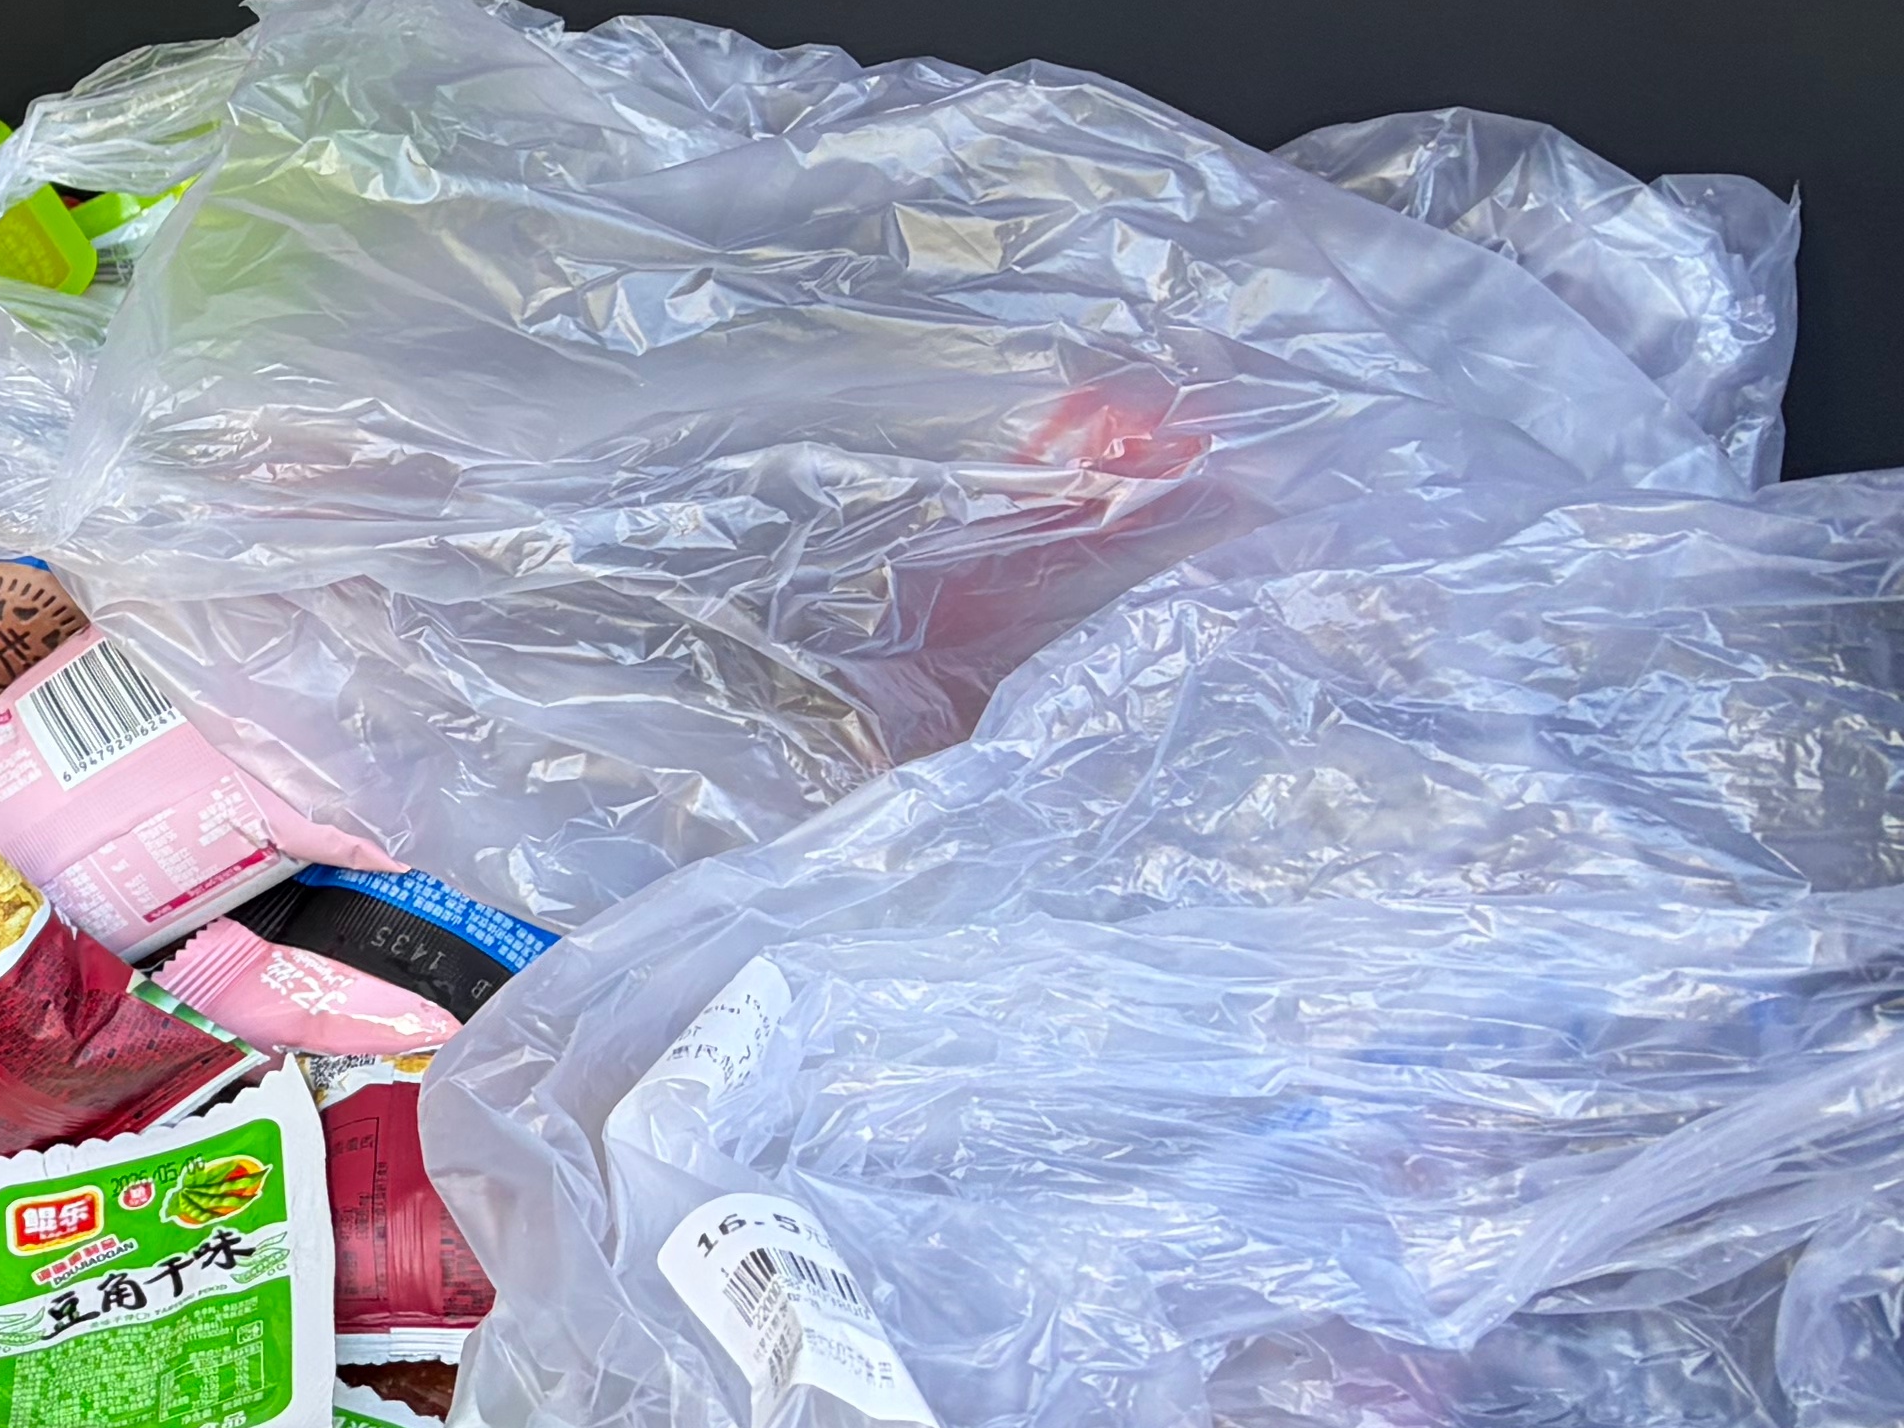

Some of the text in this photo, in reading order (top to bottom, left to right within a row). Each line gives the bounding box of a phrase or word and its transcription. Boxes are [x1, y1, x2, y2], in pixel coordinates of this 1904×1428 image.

[371, 926, 446, 970] 1435
[22, 1200, 90, 1234] 鲲乐
[42, 1230, 256, 1340] 豆角干味
